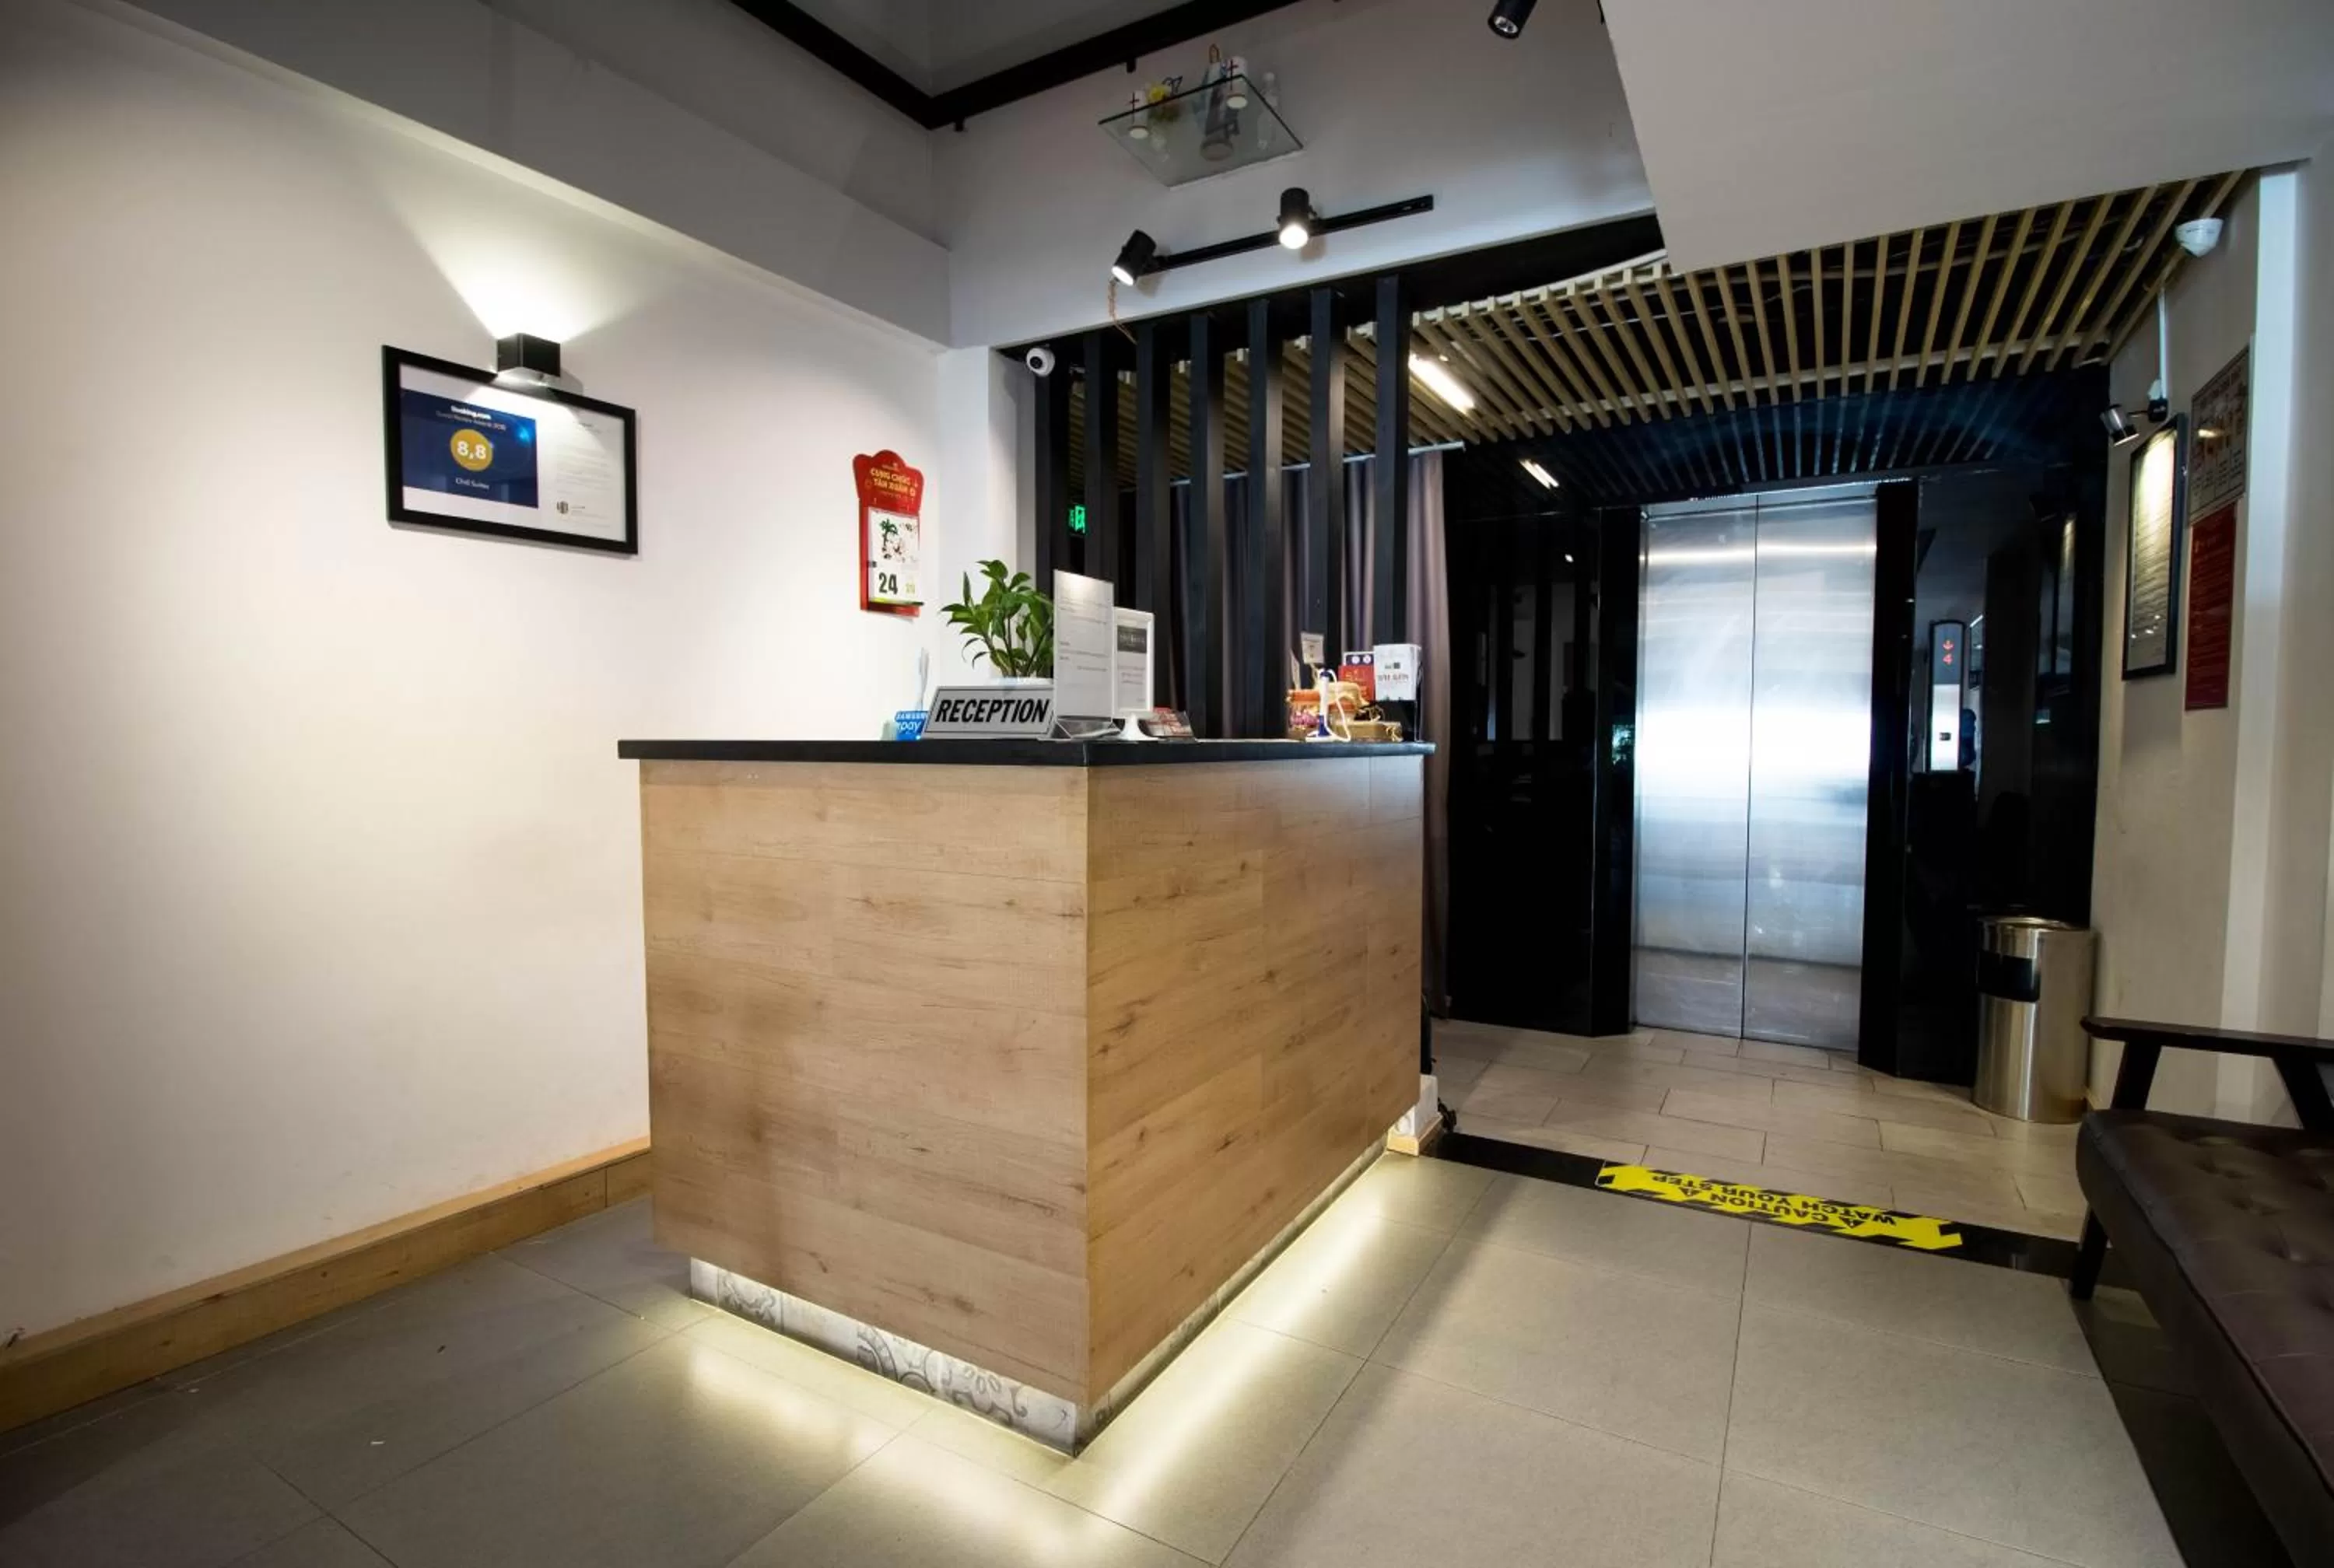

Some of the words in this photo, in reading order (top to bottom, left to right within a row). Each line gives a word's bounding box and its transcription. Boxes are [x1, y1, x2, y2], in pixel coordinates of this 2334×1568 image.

[457, 440, 486, 460] 8.8
[878, 572, 899, 595] 24
[896, 712, 926, 720] SAMSUN
[935, 698, 1050, 723] RECEPTION
[1652, 1174, 1712, 1191] STEP
[1722, 1185, 1791, 1206] YOUR
[1710, 1193, 1829, 1222] CAUTION
[1801, 1200, 1897, 1227] WATCH
